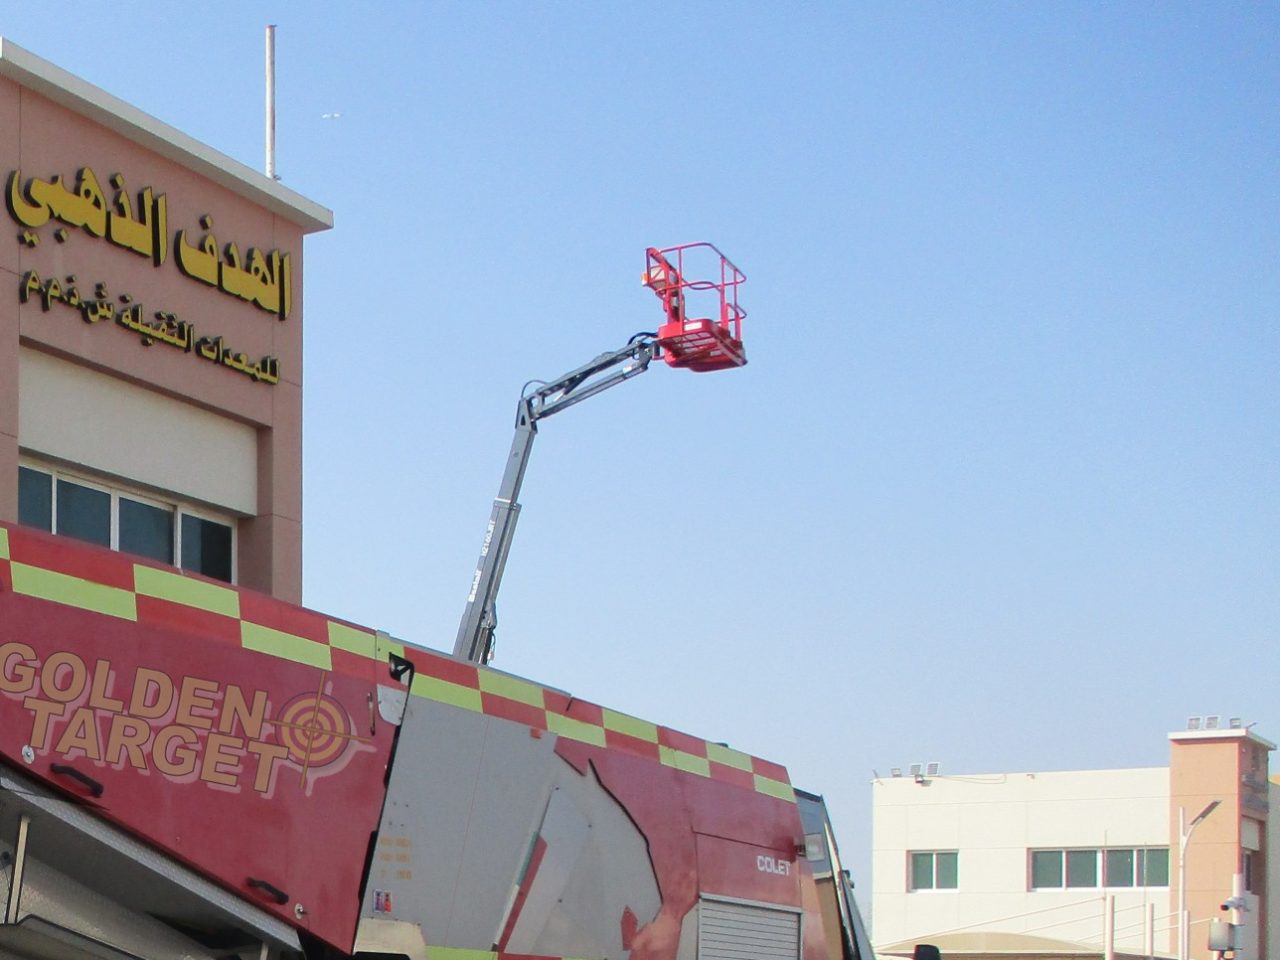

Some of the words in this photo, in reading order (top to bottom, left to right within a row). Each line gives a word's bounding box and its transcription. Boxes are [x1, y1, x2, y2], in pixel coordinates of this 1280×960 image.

[5, 167, 167, 267] الذهبي
[174, 214, 291, 321] الهدف
[116, 293, 194, 352] الثقيلة
[195, 336, 280, 384] للمعدات
[23, 696, 290, 794] TARGET
[757, 855, 791, 876] COLET
